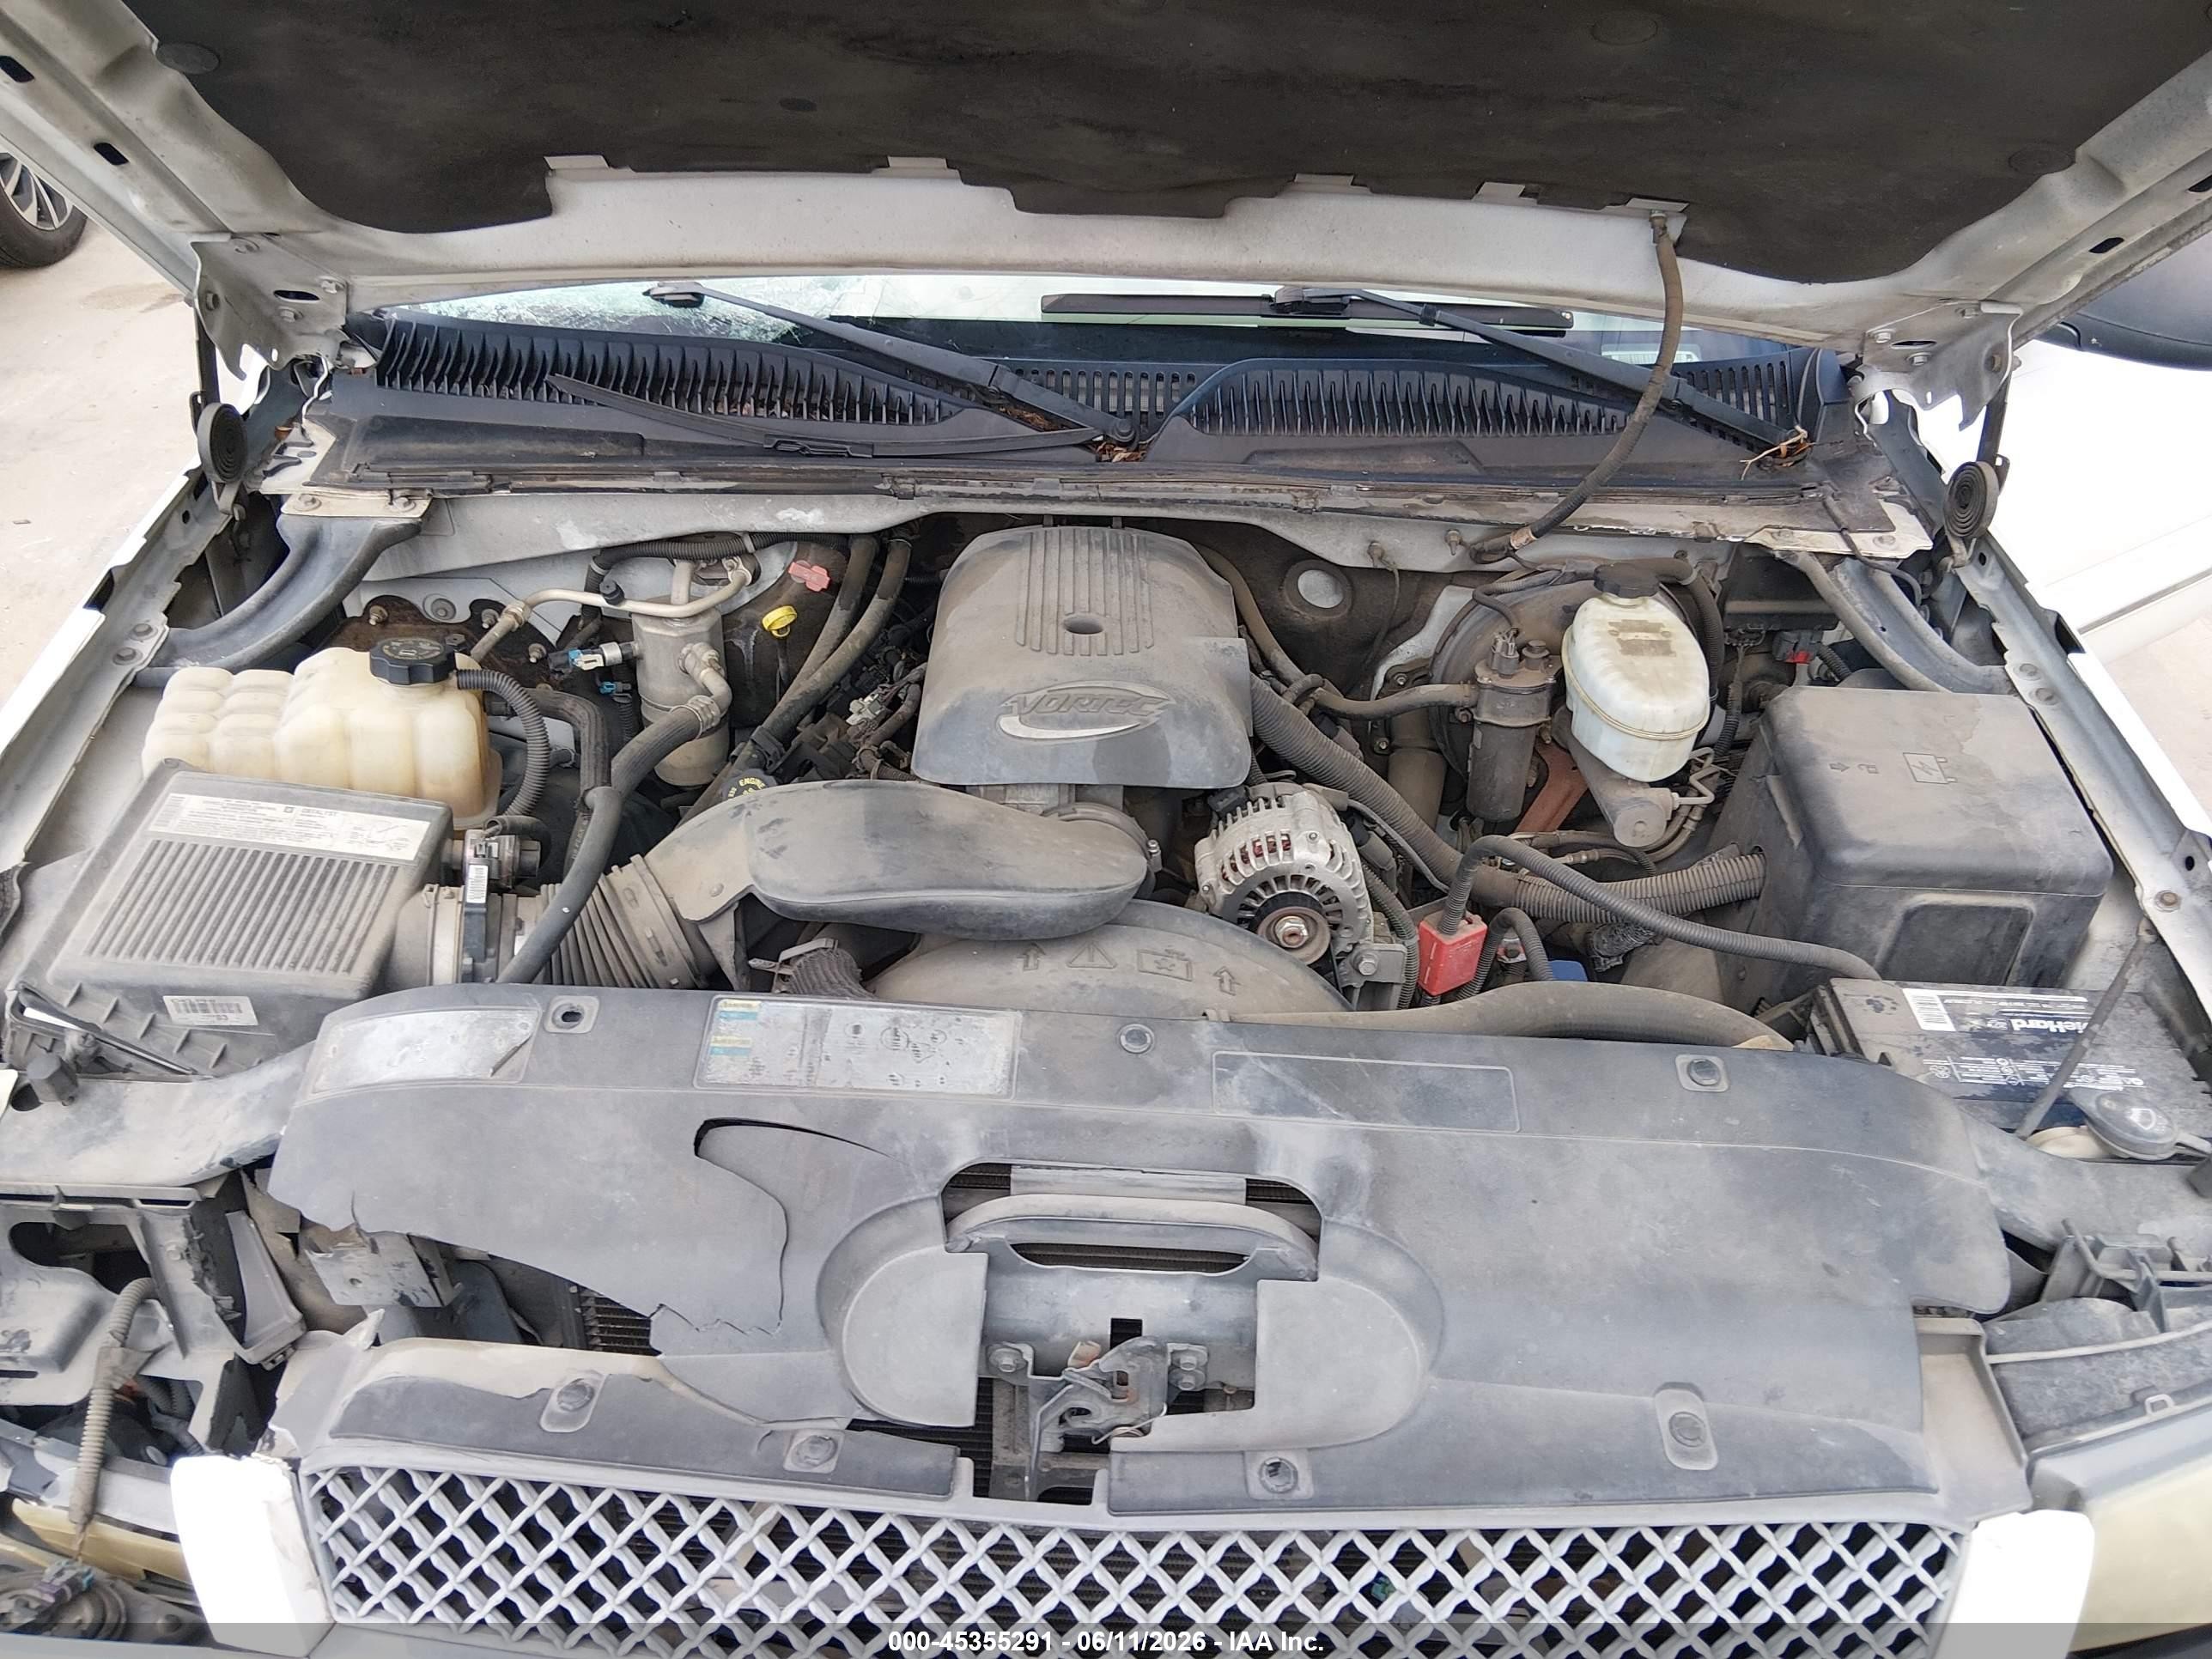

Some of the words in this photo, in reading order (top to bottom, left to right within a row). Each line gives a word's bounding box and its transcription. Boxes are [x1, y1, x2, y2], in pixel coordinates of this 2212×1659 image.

[1010, 694, 1166, 717] VORTEC
[738, 777, 766, 790] ENGINE
[2010, 1018, 2089, 1034] ieHard
